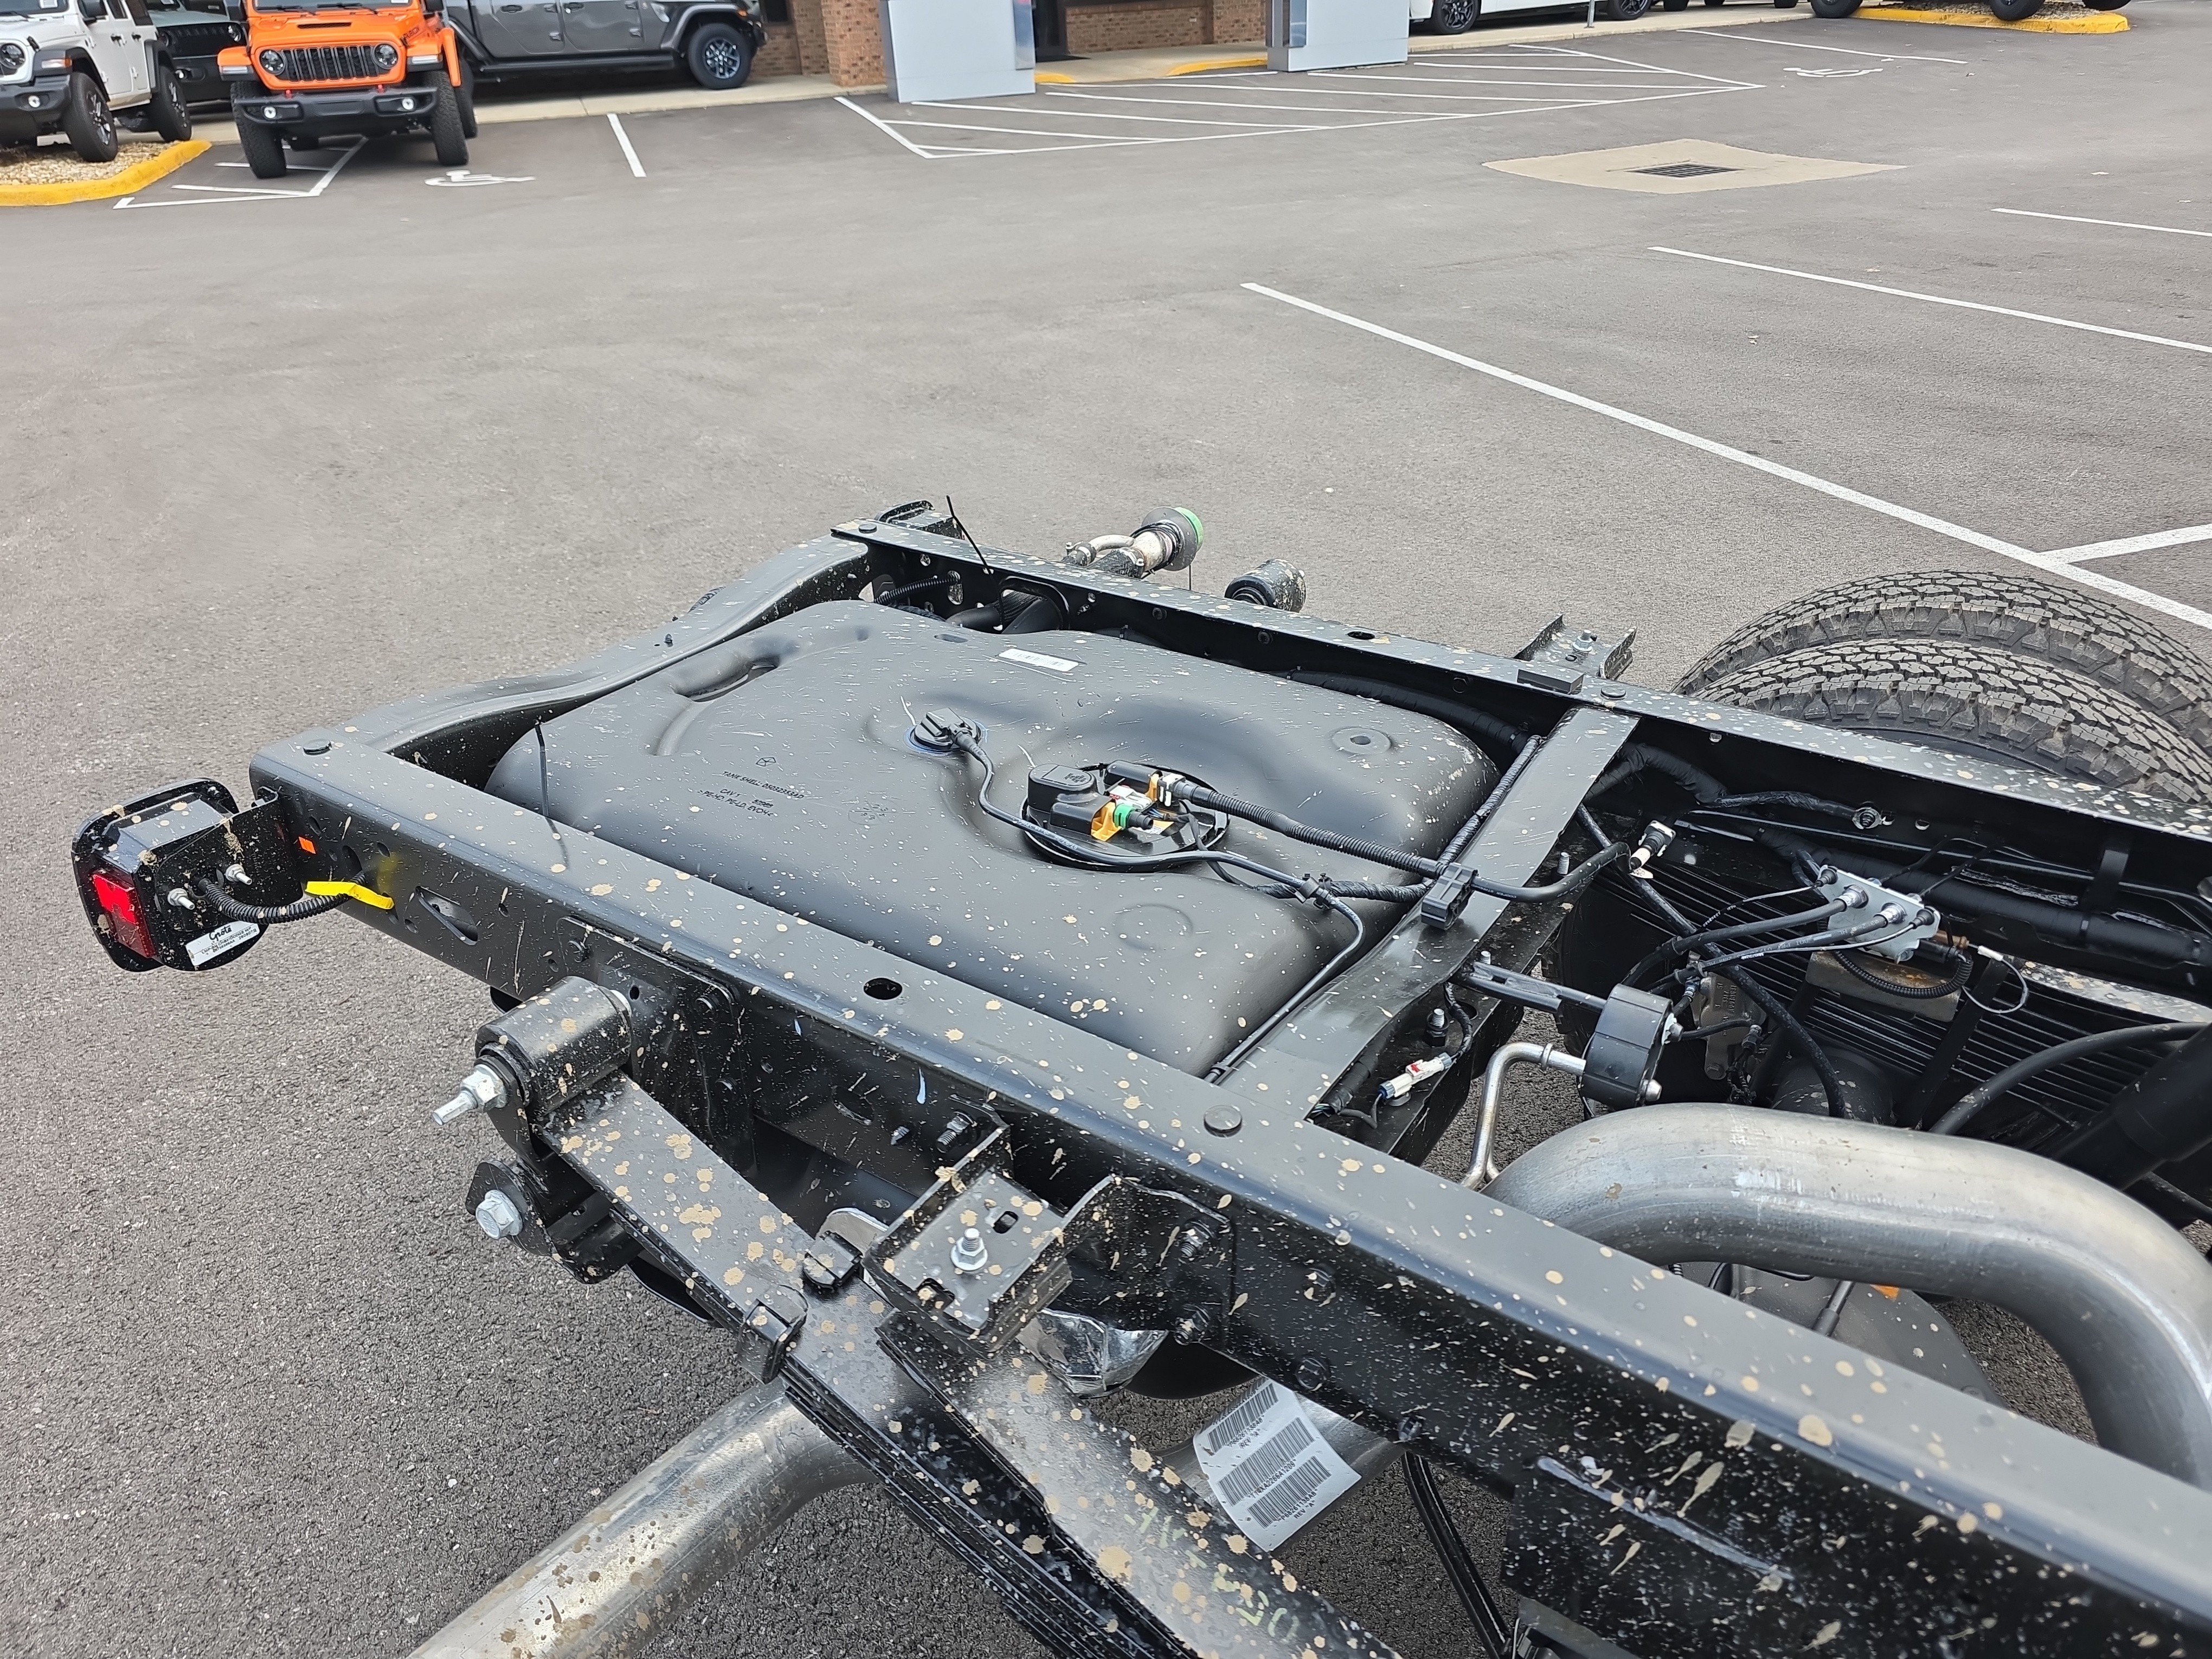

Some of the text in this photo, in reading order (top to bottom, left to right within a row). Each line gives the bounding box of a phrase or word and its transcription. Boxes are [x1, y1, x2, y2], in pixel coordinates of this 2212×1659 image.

[723, 771, 741, 780] TANK
[209, 925, 232, 941] Grote
[1293, 1507, 1306, 1520] REV
